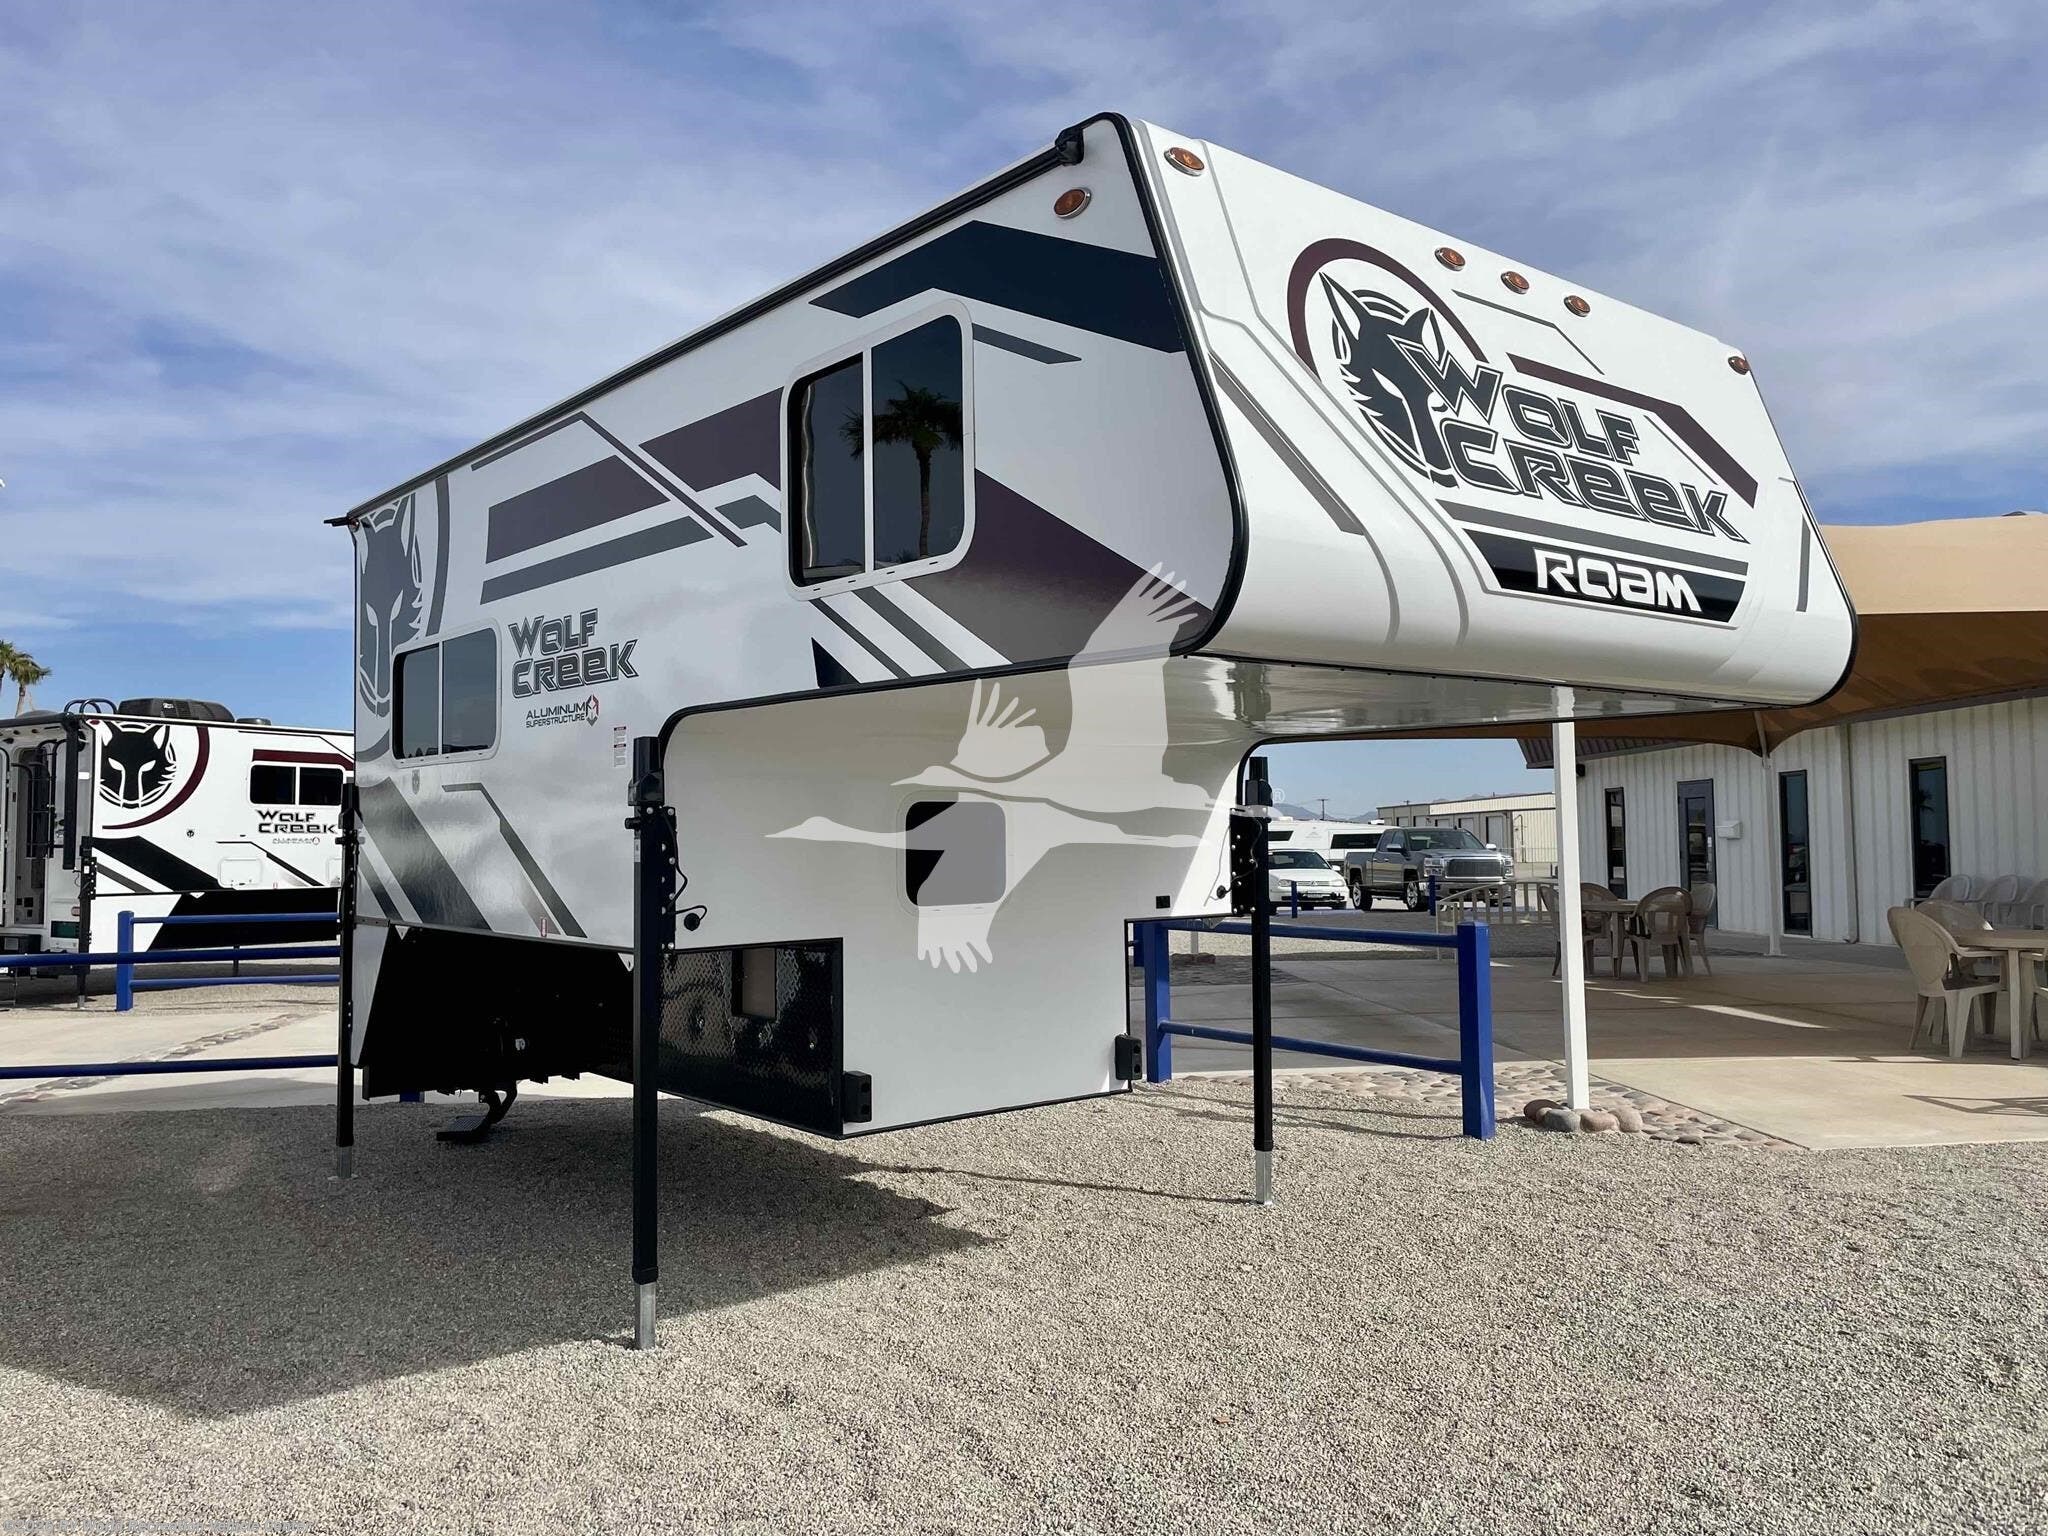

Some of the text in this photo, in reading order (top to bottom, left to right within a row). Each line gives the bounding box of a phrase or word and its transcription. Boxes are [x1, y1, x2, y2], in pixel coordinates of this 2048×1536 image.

[1387, 334, 1640, 467] WOLF
[508, 608, 598, 658] WOLF
[526, 702, 586, 720] ALUMINUM
[525, 713, 586, 728] SUPERSTRUCTURE
[255, 809, 316, 822] WOLF
